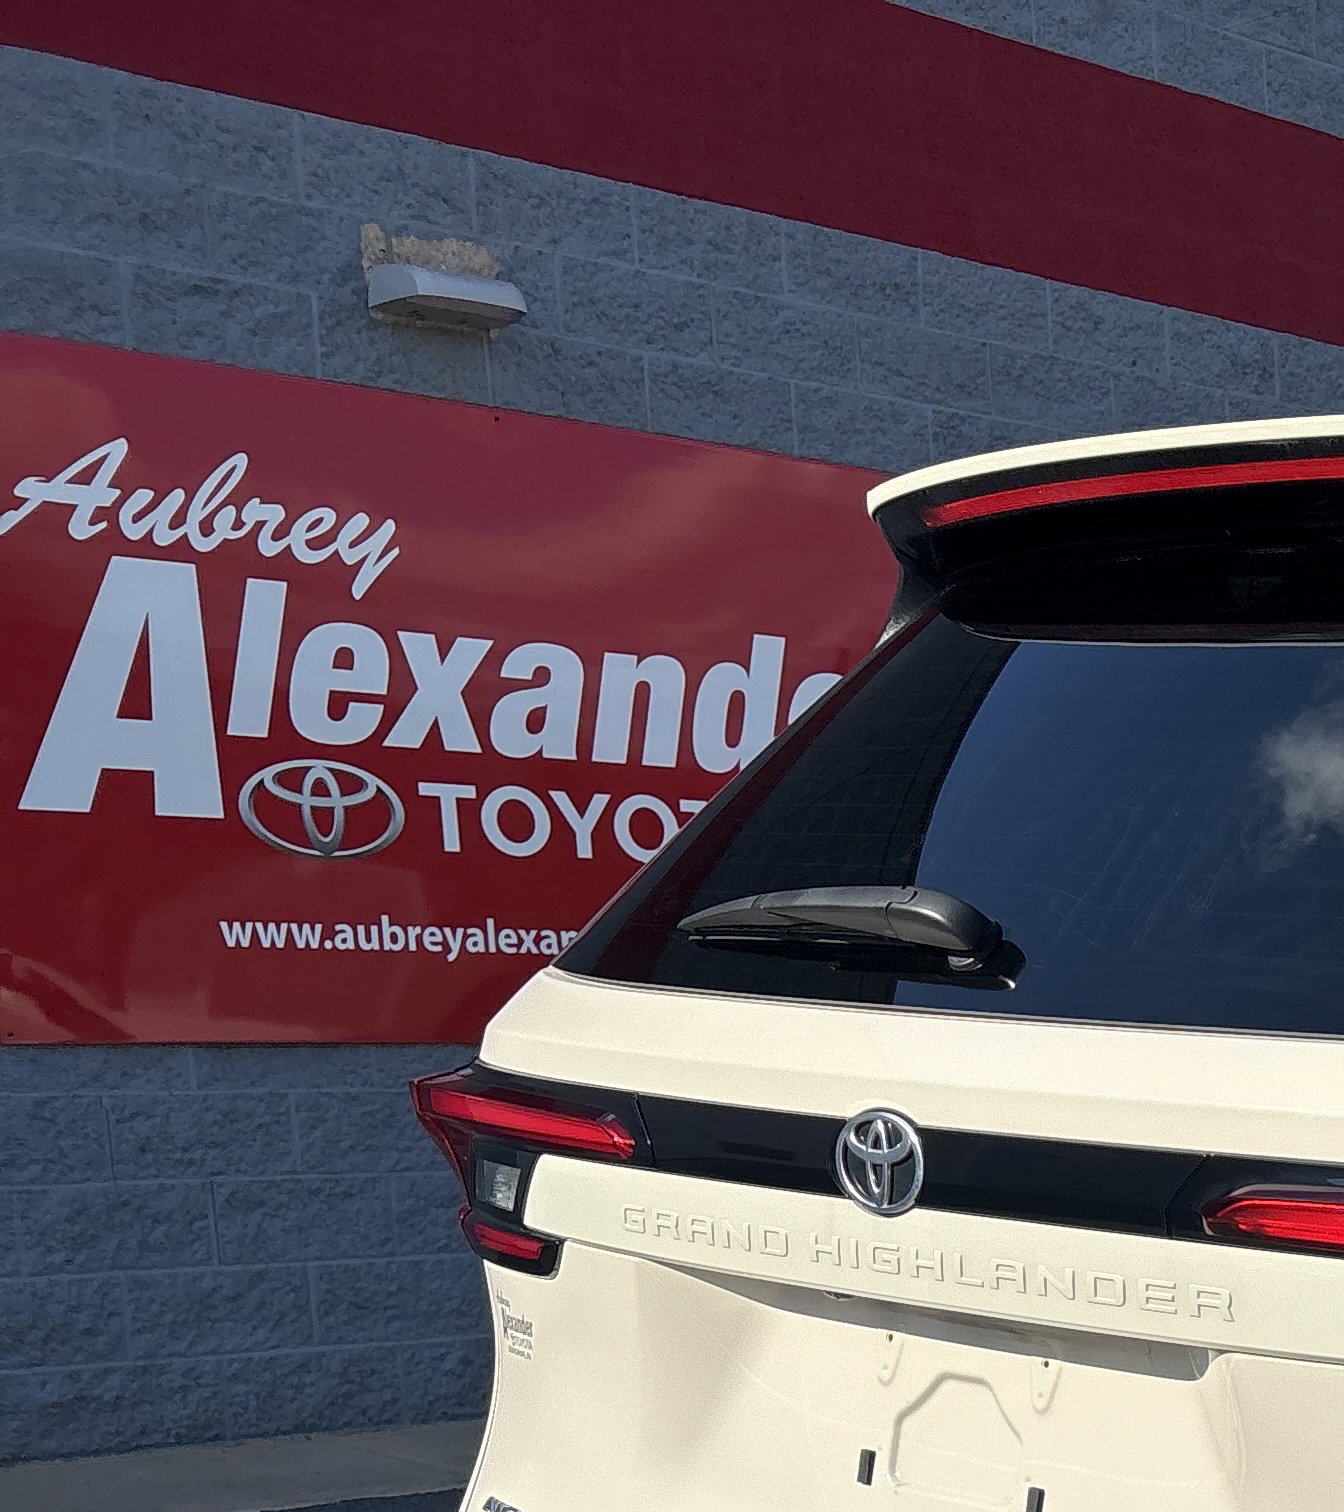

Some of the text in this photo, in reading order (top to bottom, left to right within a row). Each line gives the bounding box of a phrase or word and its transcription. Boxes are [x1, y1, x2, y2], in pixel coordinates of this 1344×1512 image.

[0, 437, 400, 600] Aubrey
[622, 1205, 1236, 1322] GRAND HIGHLANDER
